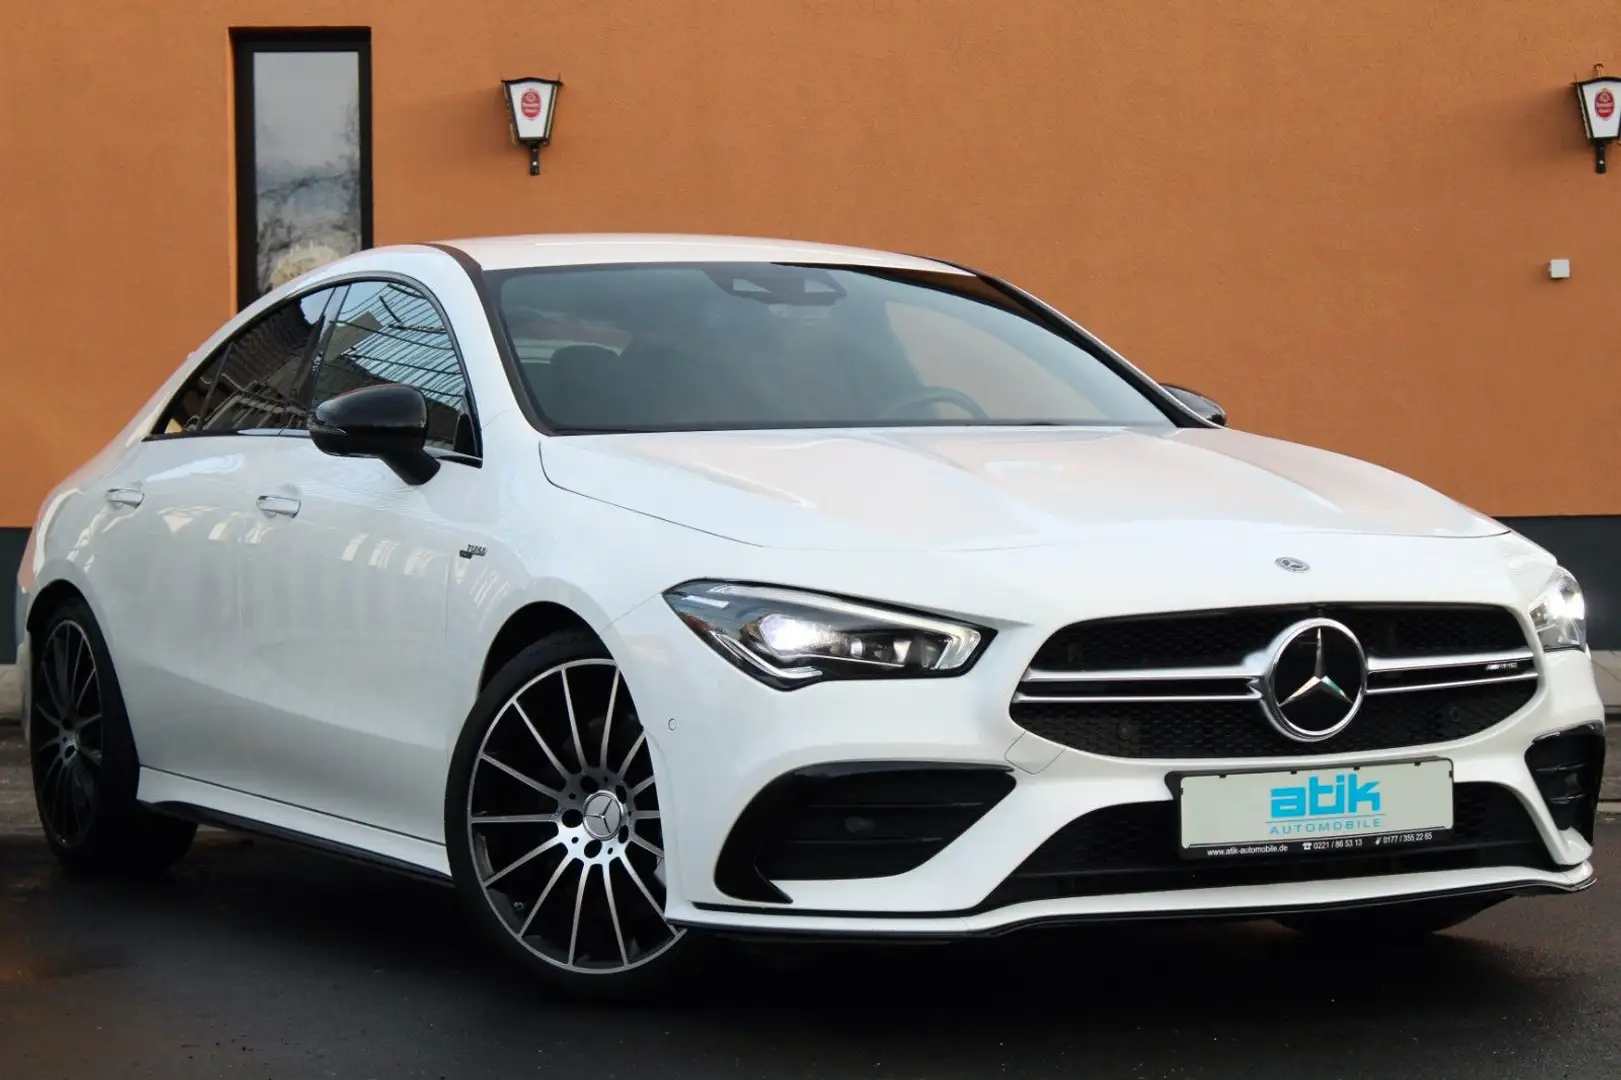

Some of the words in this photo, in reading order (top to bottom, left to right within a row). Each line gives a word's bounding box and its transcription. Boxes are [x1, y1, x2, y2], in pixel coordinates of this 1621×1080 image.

[1271, 773, 1380, 818] atik
[1270, 818, 1381, 835] AUTOMOBILE
[1313, 841, 1330, 849] 0221
[1355, 838, 1363, 846] 13
[1383, 835, 1398, 844] 0177
[1403, 833, 1415, 842] 355
[1415, 832, 1424, 841] 22
[1424, 832, 1433, 840] 65
[1207, 844, 1288, 856] www.atik-automobile.de
